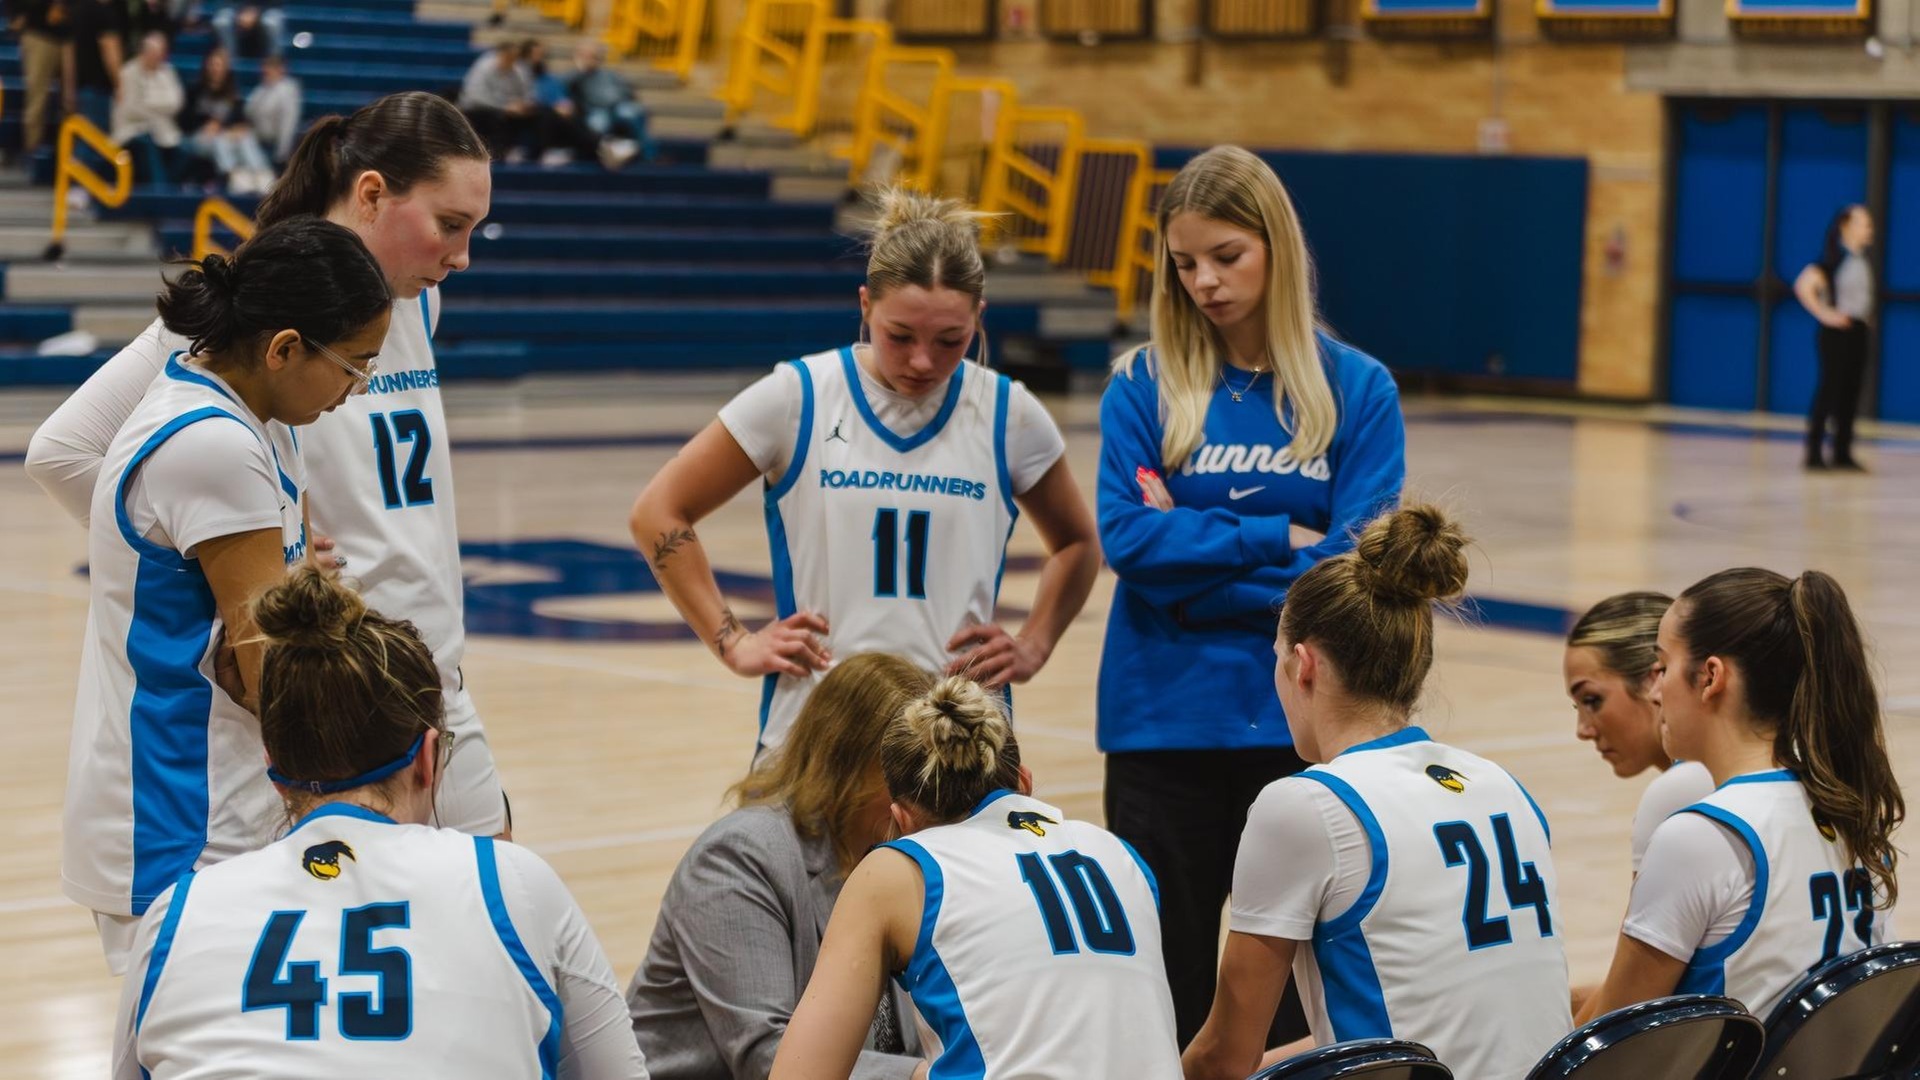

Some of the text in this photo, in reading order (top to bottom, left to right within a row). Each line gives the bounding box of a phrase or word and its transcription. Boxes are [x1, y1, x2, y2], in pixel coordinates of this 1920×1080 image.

[368, 409, 434, 510] 12
[820, 469, 986, 500] ROADRUNNERS
[1181, 431, 1331, 481] unnes
[872, 507, 930, 600] 11
[1015, 849, 1136, 956] 10
[1433, 812, 1553, 951] 24
[241, 900, 413, 1041] 45
